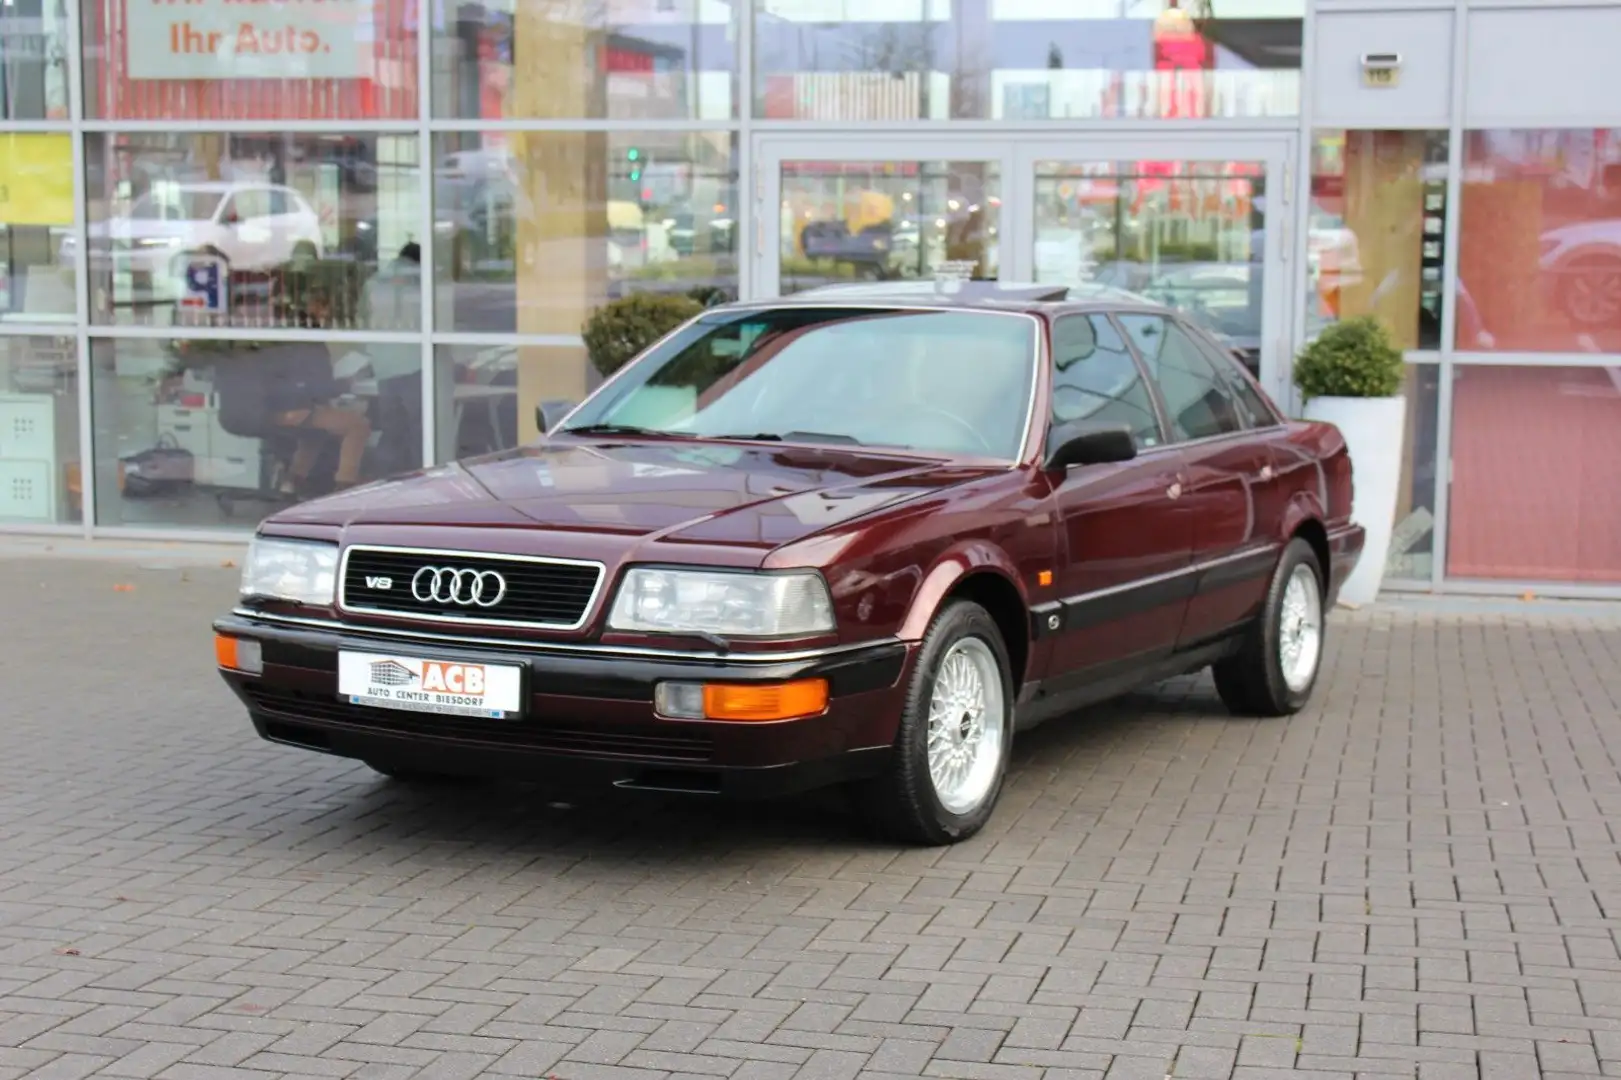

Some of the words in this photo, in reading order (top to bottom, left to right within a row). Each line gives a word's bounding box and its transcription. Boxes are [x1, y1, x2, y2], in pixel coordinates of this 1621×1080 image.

[169, 22, 221, 53] Ihr
[234, 22, 331, 54] Auto.
[365, 576, 393, 589] V8
[422, 663, 484, 694] ACB
[367, 687, 390, 698] AUTO
[396, 691, 430, 703] CENTER
[436, 694, 484, 706] BIESDORF
